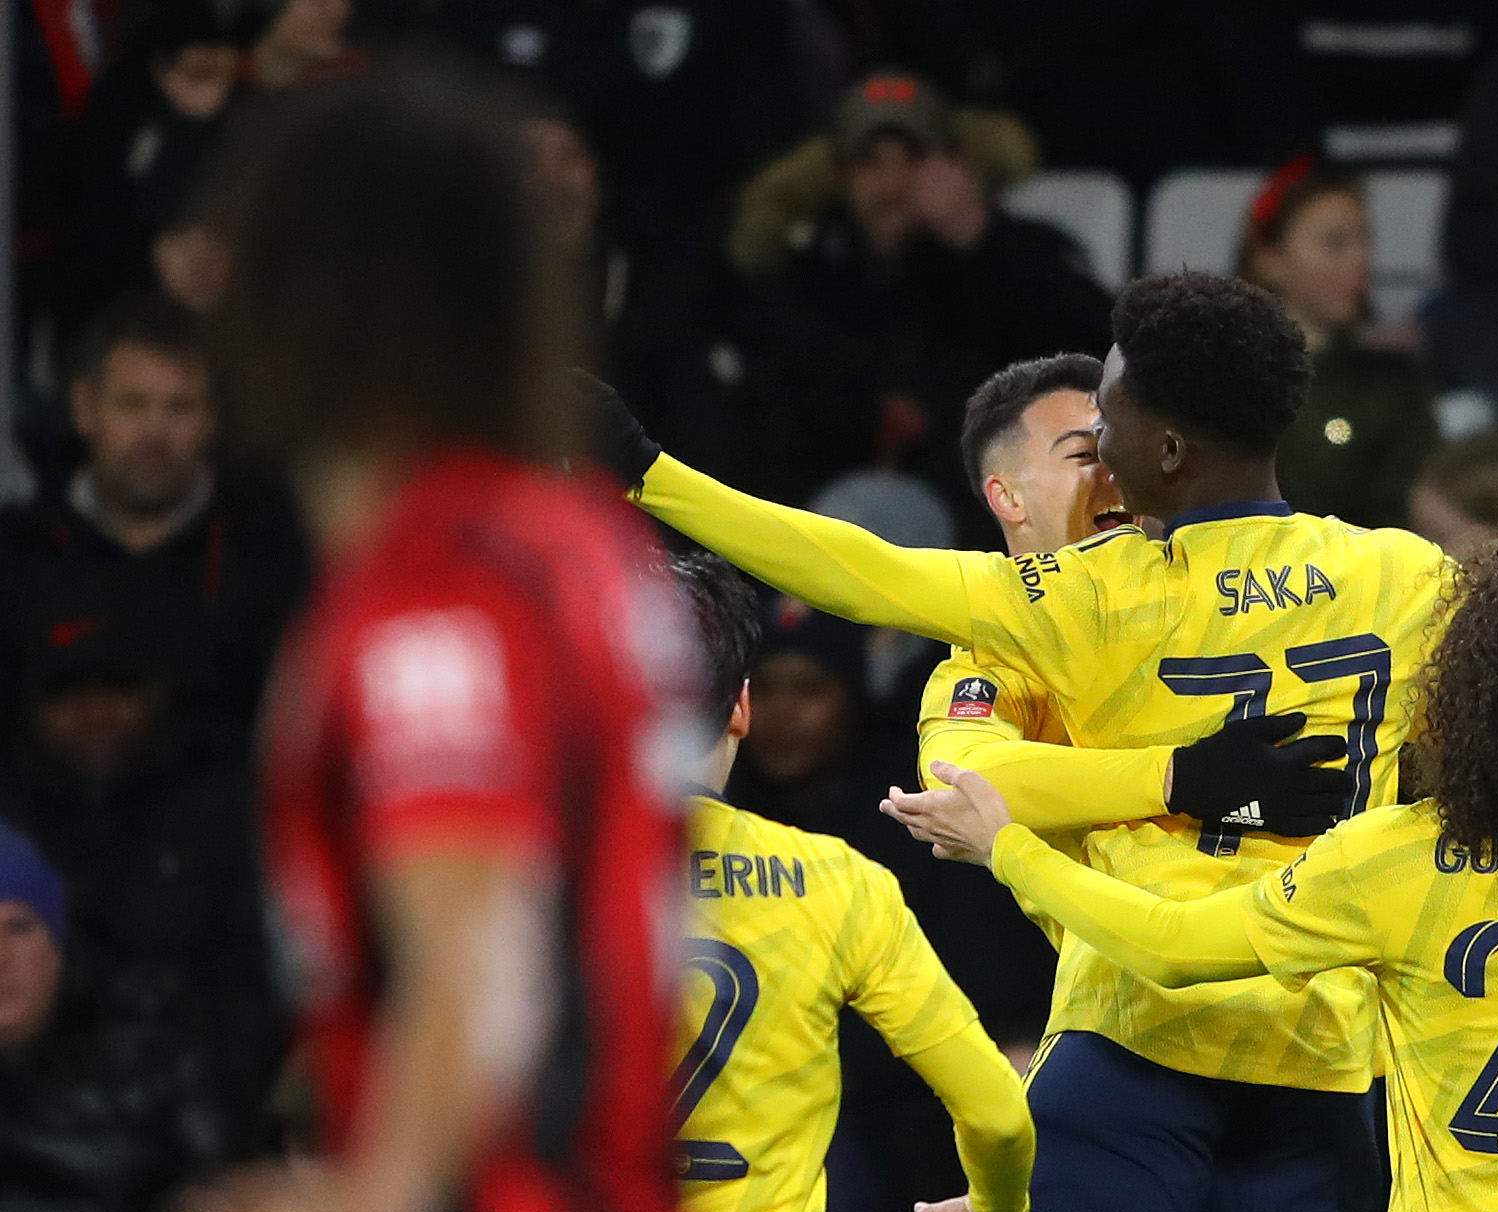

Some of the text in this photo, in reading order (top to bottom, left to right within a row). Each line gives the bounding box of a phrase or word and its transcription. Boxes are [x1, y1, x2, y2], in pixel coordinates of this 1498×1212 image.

[1216, 563, 1337, 616] SAKA
[689, 850, 806, 899] ERIN
[668, 937, 760, 1182] 2
